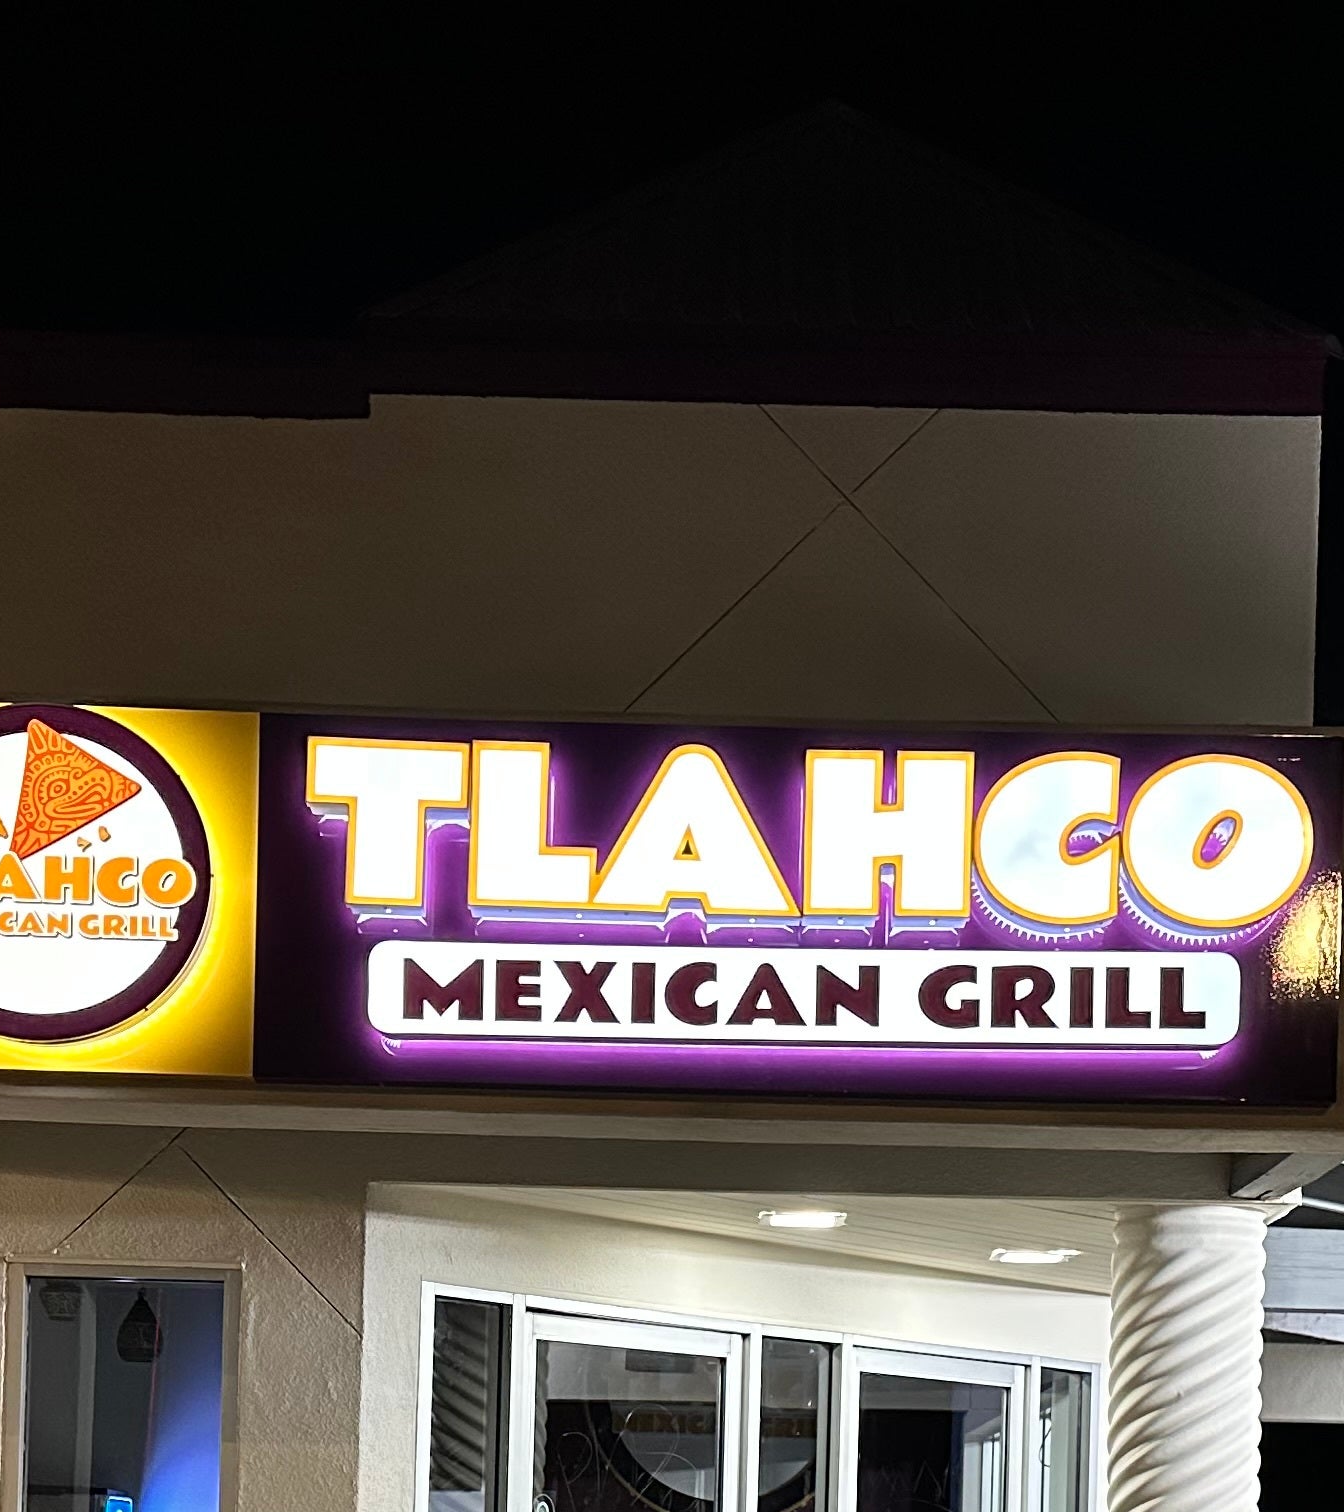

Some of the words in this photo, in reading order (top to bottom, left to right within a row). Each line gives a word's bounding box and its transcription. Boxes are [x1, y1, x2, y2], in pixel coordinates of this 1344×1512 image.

[306, 736, 1314, 928] TLAHCO
[79, 914, 175, 938] GRILL
[403, 957, 880, 1027] MEXICAN
[918, 964, 1207, 1030] GRILL
